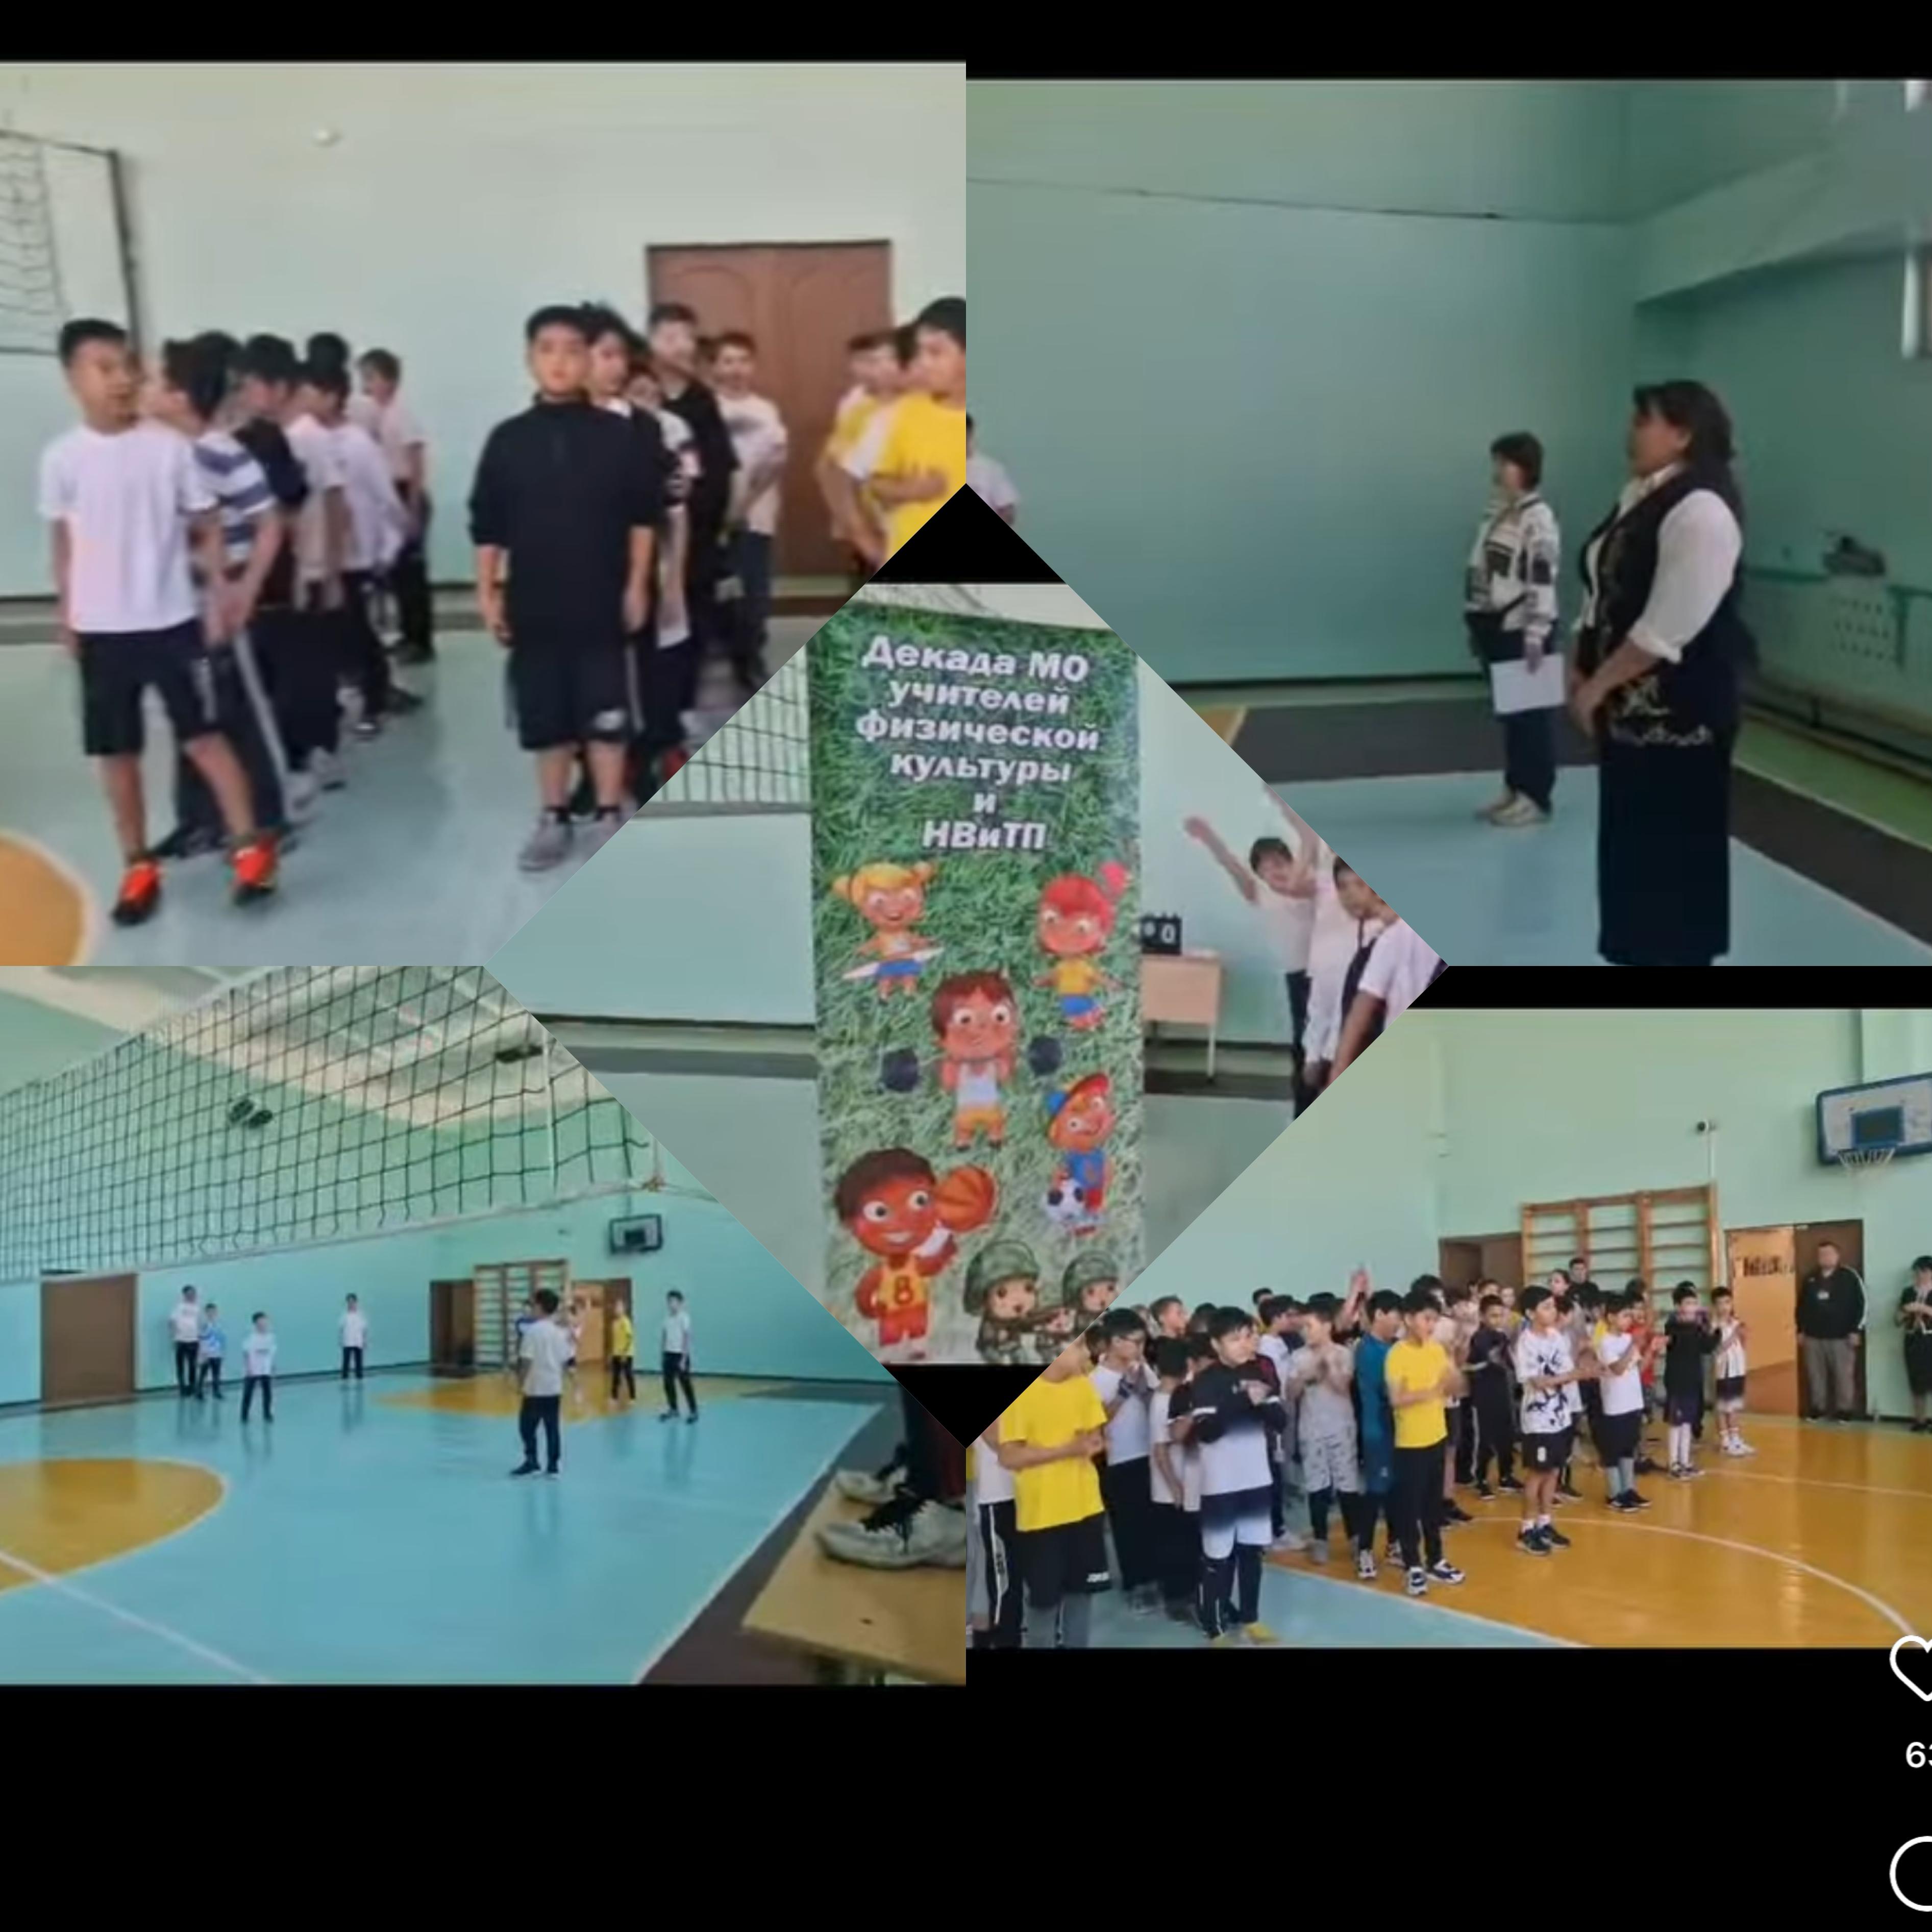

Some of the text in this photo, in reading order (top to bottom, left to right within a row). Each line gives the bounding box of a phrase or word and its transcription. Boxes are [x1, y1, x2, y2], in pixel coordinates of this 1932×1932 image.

[862, 635, 1090, 683] Декада МО
[888, 680, 1069, 714] учителей
[855, 709, 1099, 751] физической
[889, 753, 1071, 786] культуры
[974, 792, 996, 813] и
[923, 821, 1047, 850] НВиТП
[895, 1276, 914, 1304] 8
